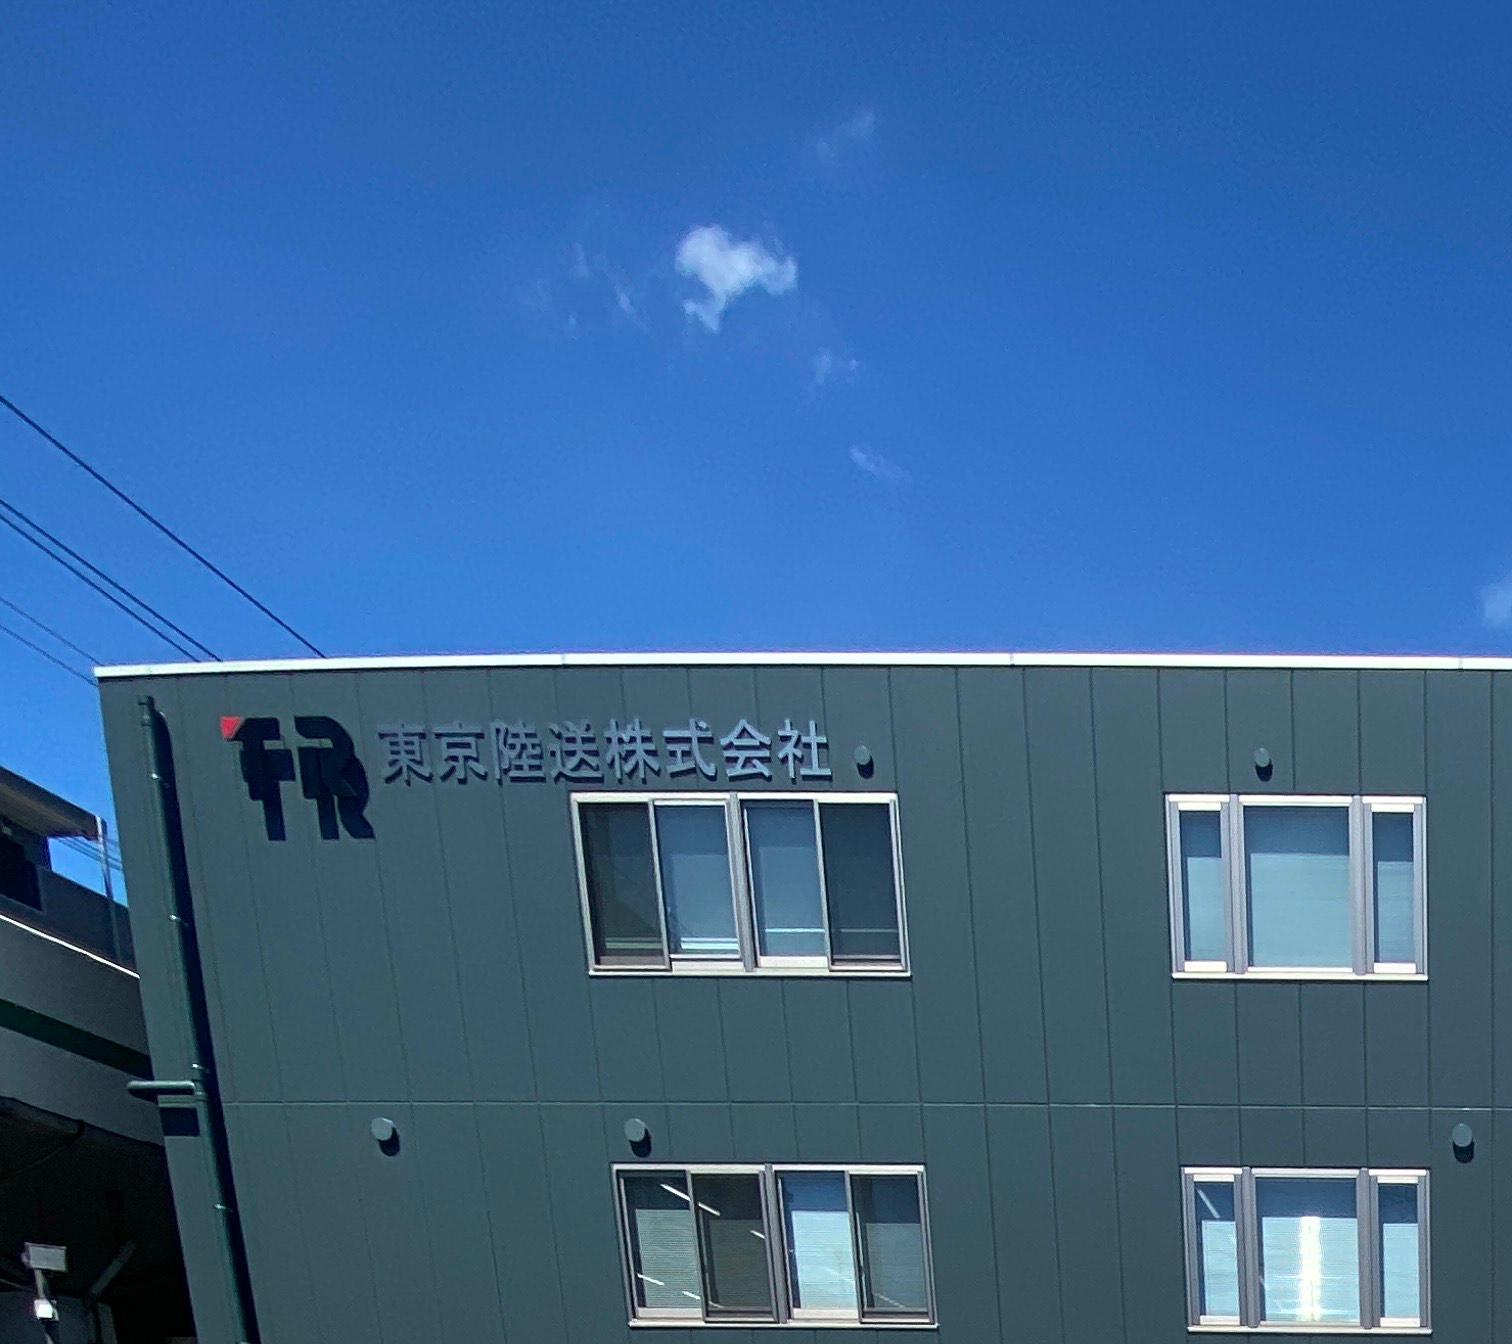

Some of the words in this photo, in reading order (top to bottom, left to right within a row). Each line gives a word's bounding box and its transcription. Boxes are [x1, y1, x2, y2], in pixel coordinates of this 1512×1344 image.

[378, 718, 834, 786] 東京陸送株式会社
